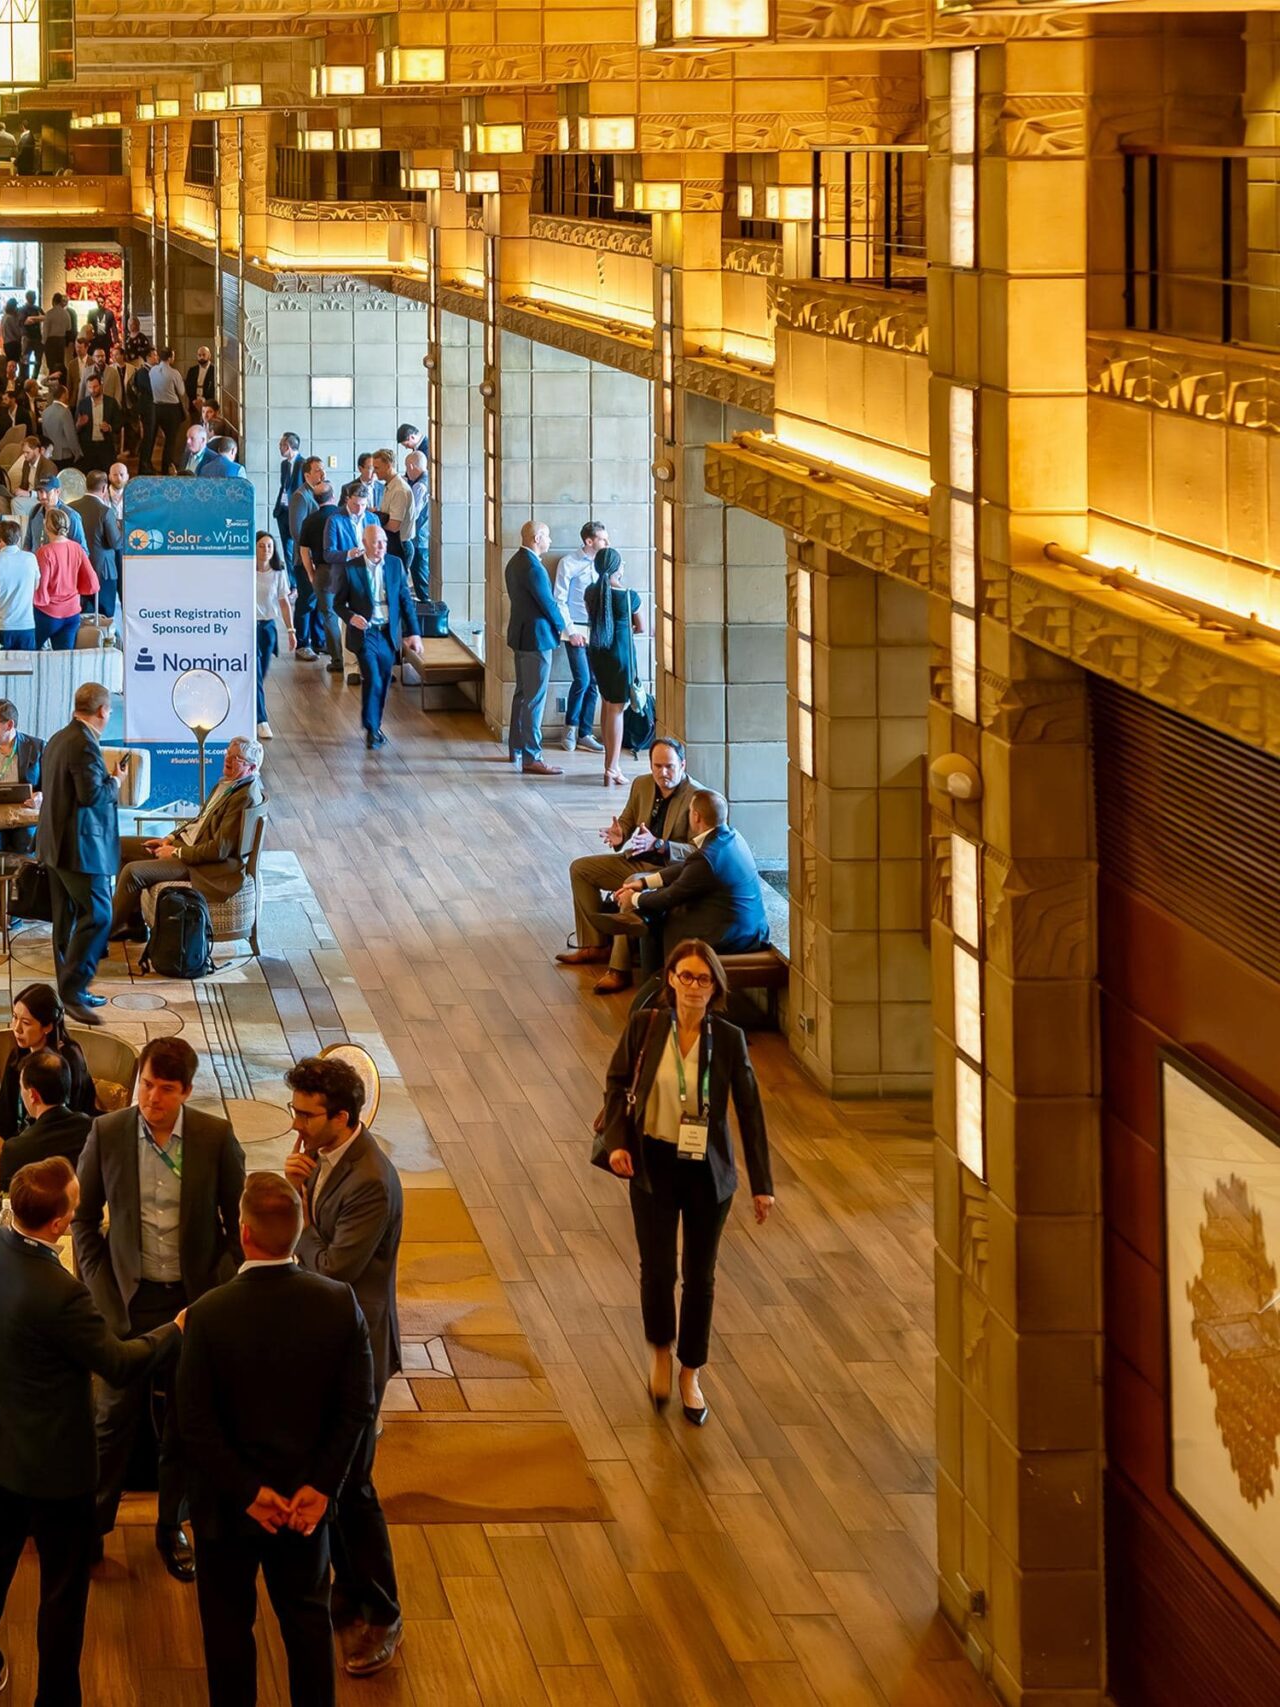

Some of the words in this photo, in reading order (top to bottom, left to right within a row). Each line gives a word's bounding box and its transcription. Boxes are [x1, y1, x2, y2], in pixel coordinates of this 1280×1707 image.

[167, 529, 202, 544] Solar
[212, 529, 249, 544] Wind
[138, 608, 171, 619] Guest
[174, 608, 241, 621] Registration
[152, 623, 211, 636] Sponsored
[213, 623, 229, 636] By
[162, 652, 248, 672] Nominal
